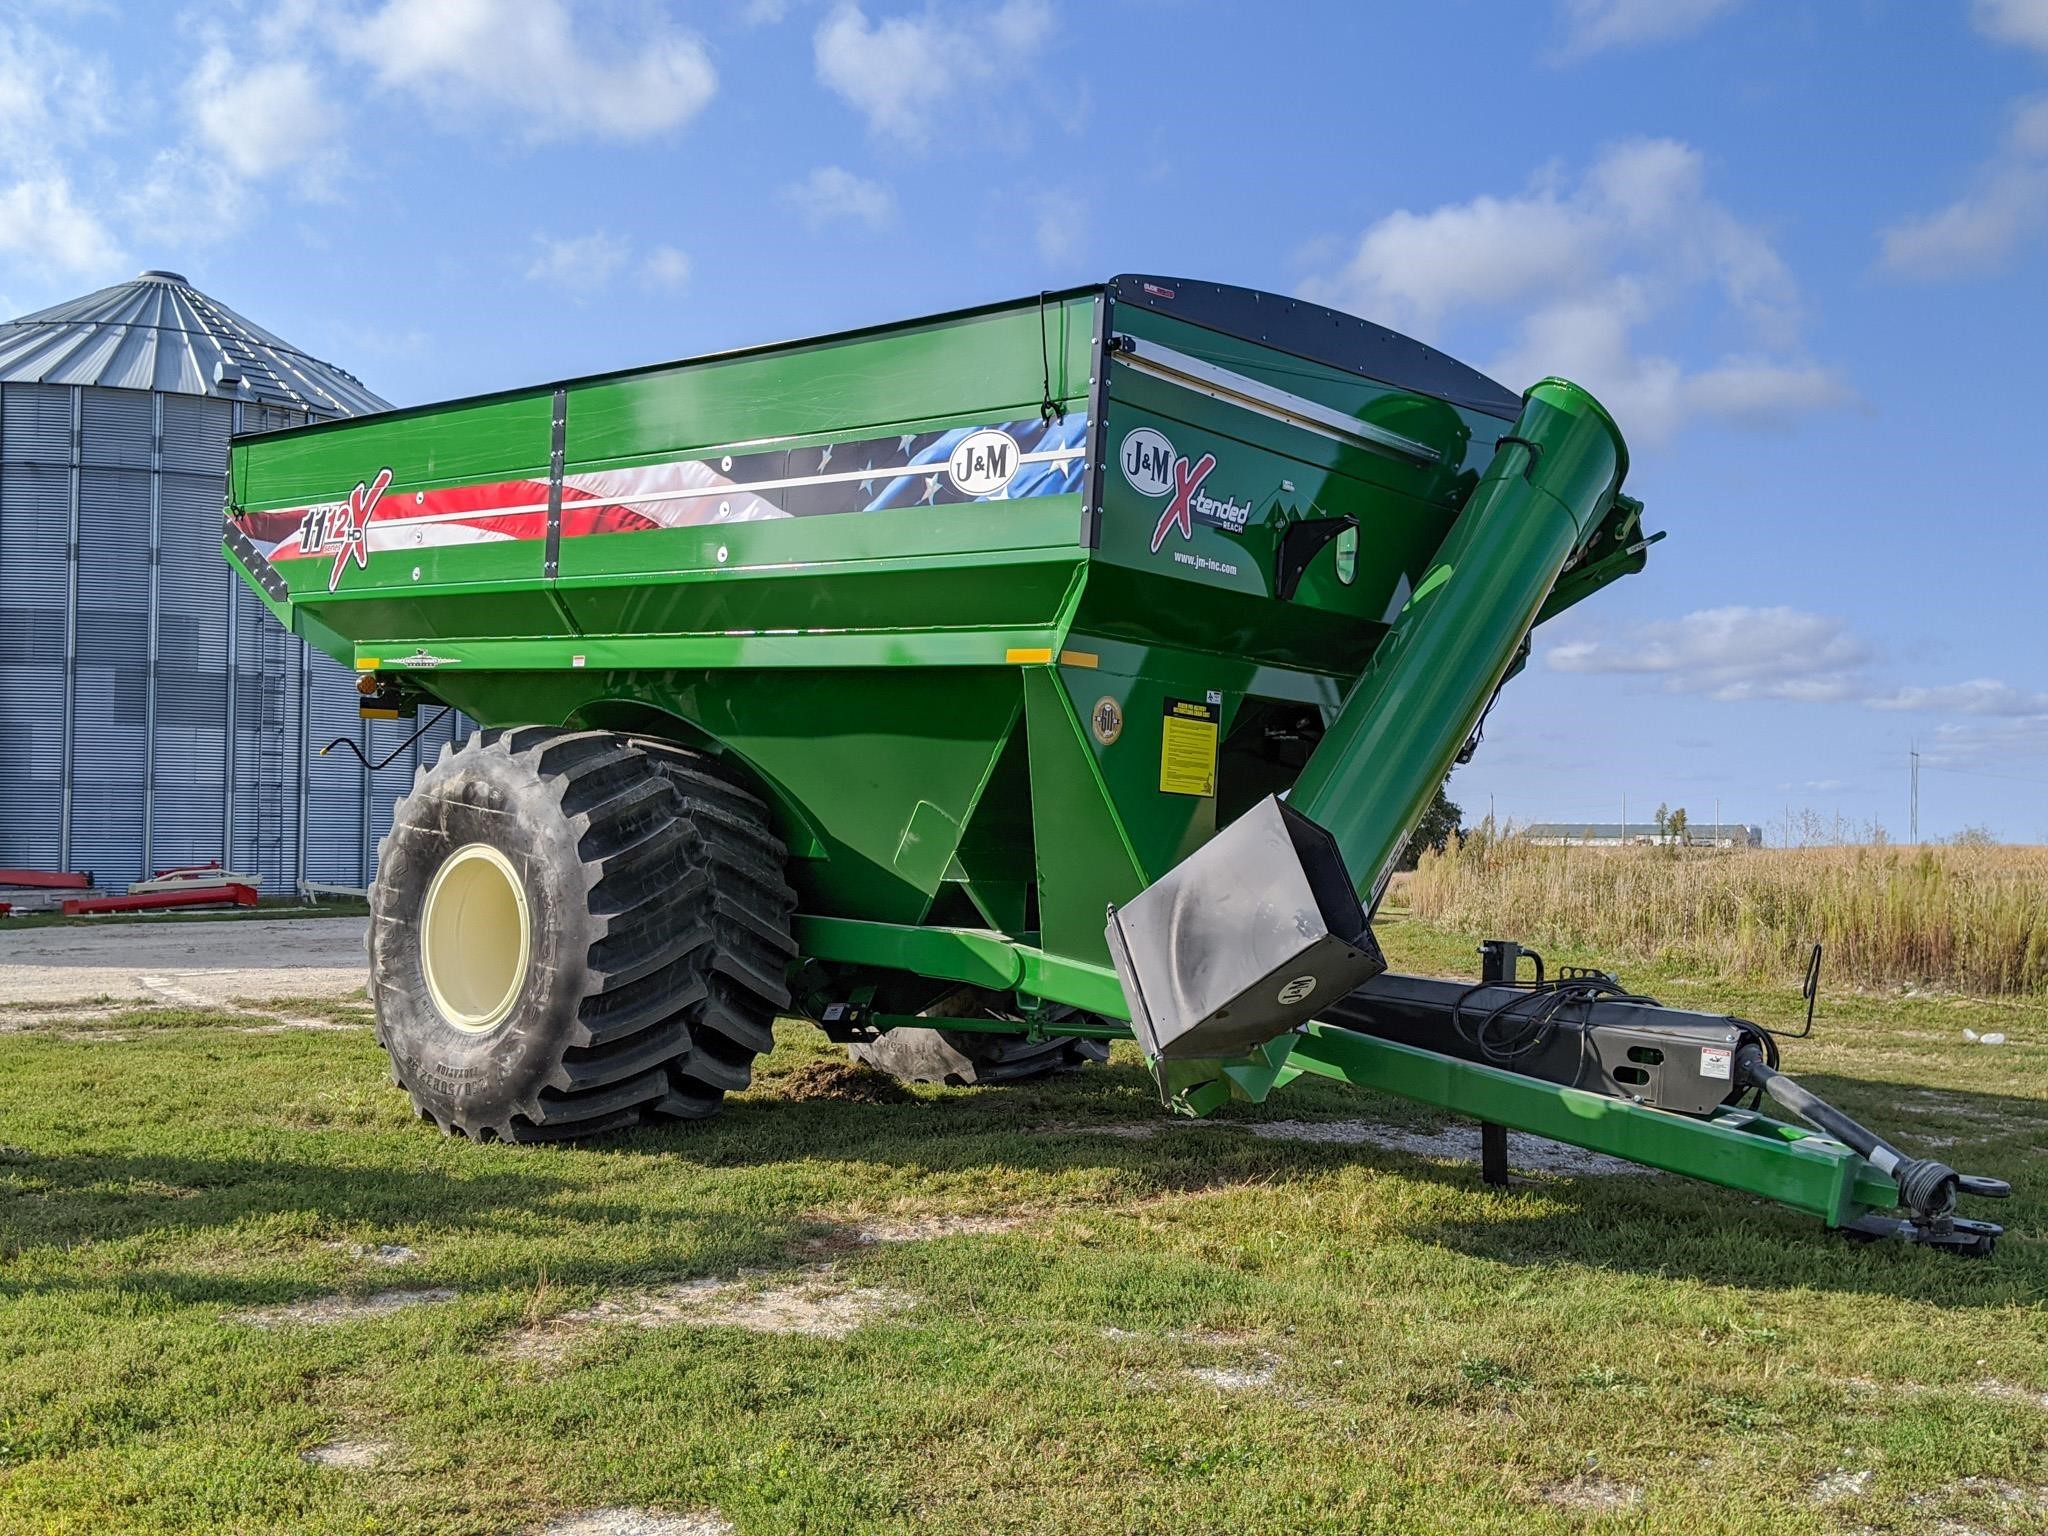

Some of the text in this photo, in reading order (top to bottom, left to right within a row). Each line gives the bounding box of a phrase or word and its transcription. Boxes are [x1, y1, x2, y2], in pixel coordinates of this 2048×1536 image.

[956, 443, 1008, 482] J&M
[1126, 441, 1171, 485] J&M
[1222, 521, 1243, 534] REACH
[1174, 551, 1237, 575] www.jm-inc.com
[1282, 979, 1313, 1003] J&M
